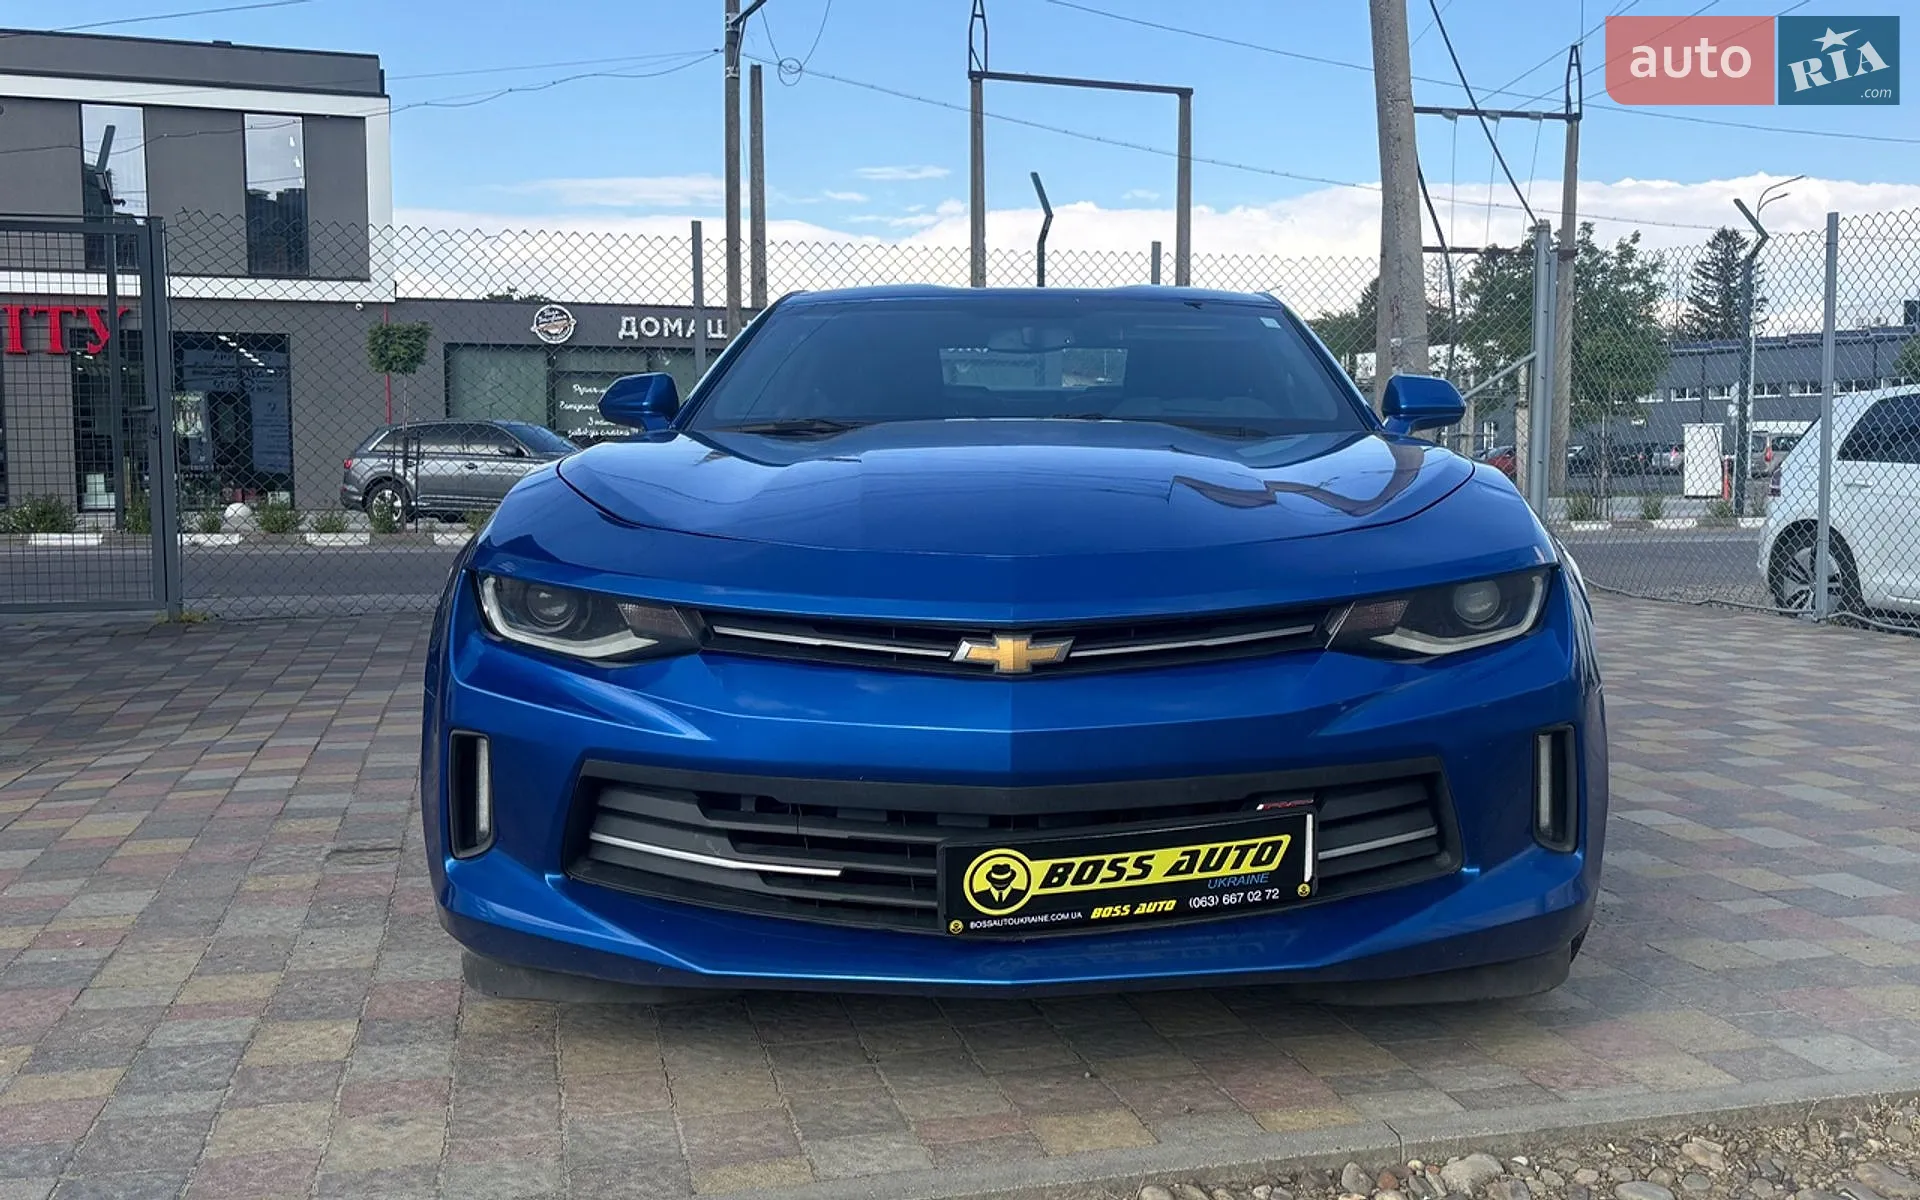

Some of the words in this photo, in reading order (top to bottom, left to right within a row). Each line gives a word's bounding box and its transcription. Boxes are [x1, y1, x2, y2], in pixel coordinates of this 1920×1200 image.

[1038, 854, 1156, 890] BOSS
[1163, 840, 1284, 877] AUTO
[1207, 872, 1271, 889] UKRAINE
[1090, 903, 1131, 919] BOSS
[1133, 899, 1177, 915] AUTO
[1189, 895, 1219, 910] (063)
[1222, 892, 1244, 906] 667
[1247, 890, 1262, 902] 02
[1265, 888, 1280, 900] 72
